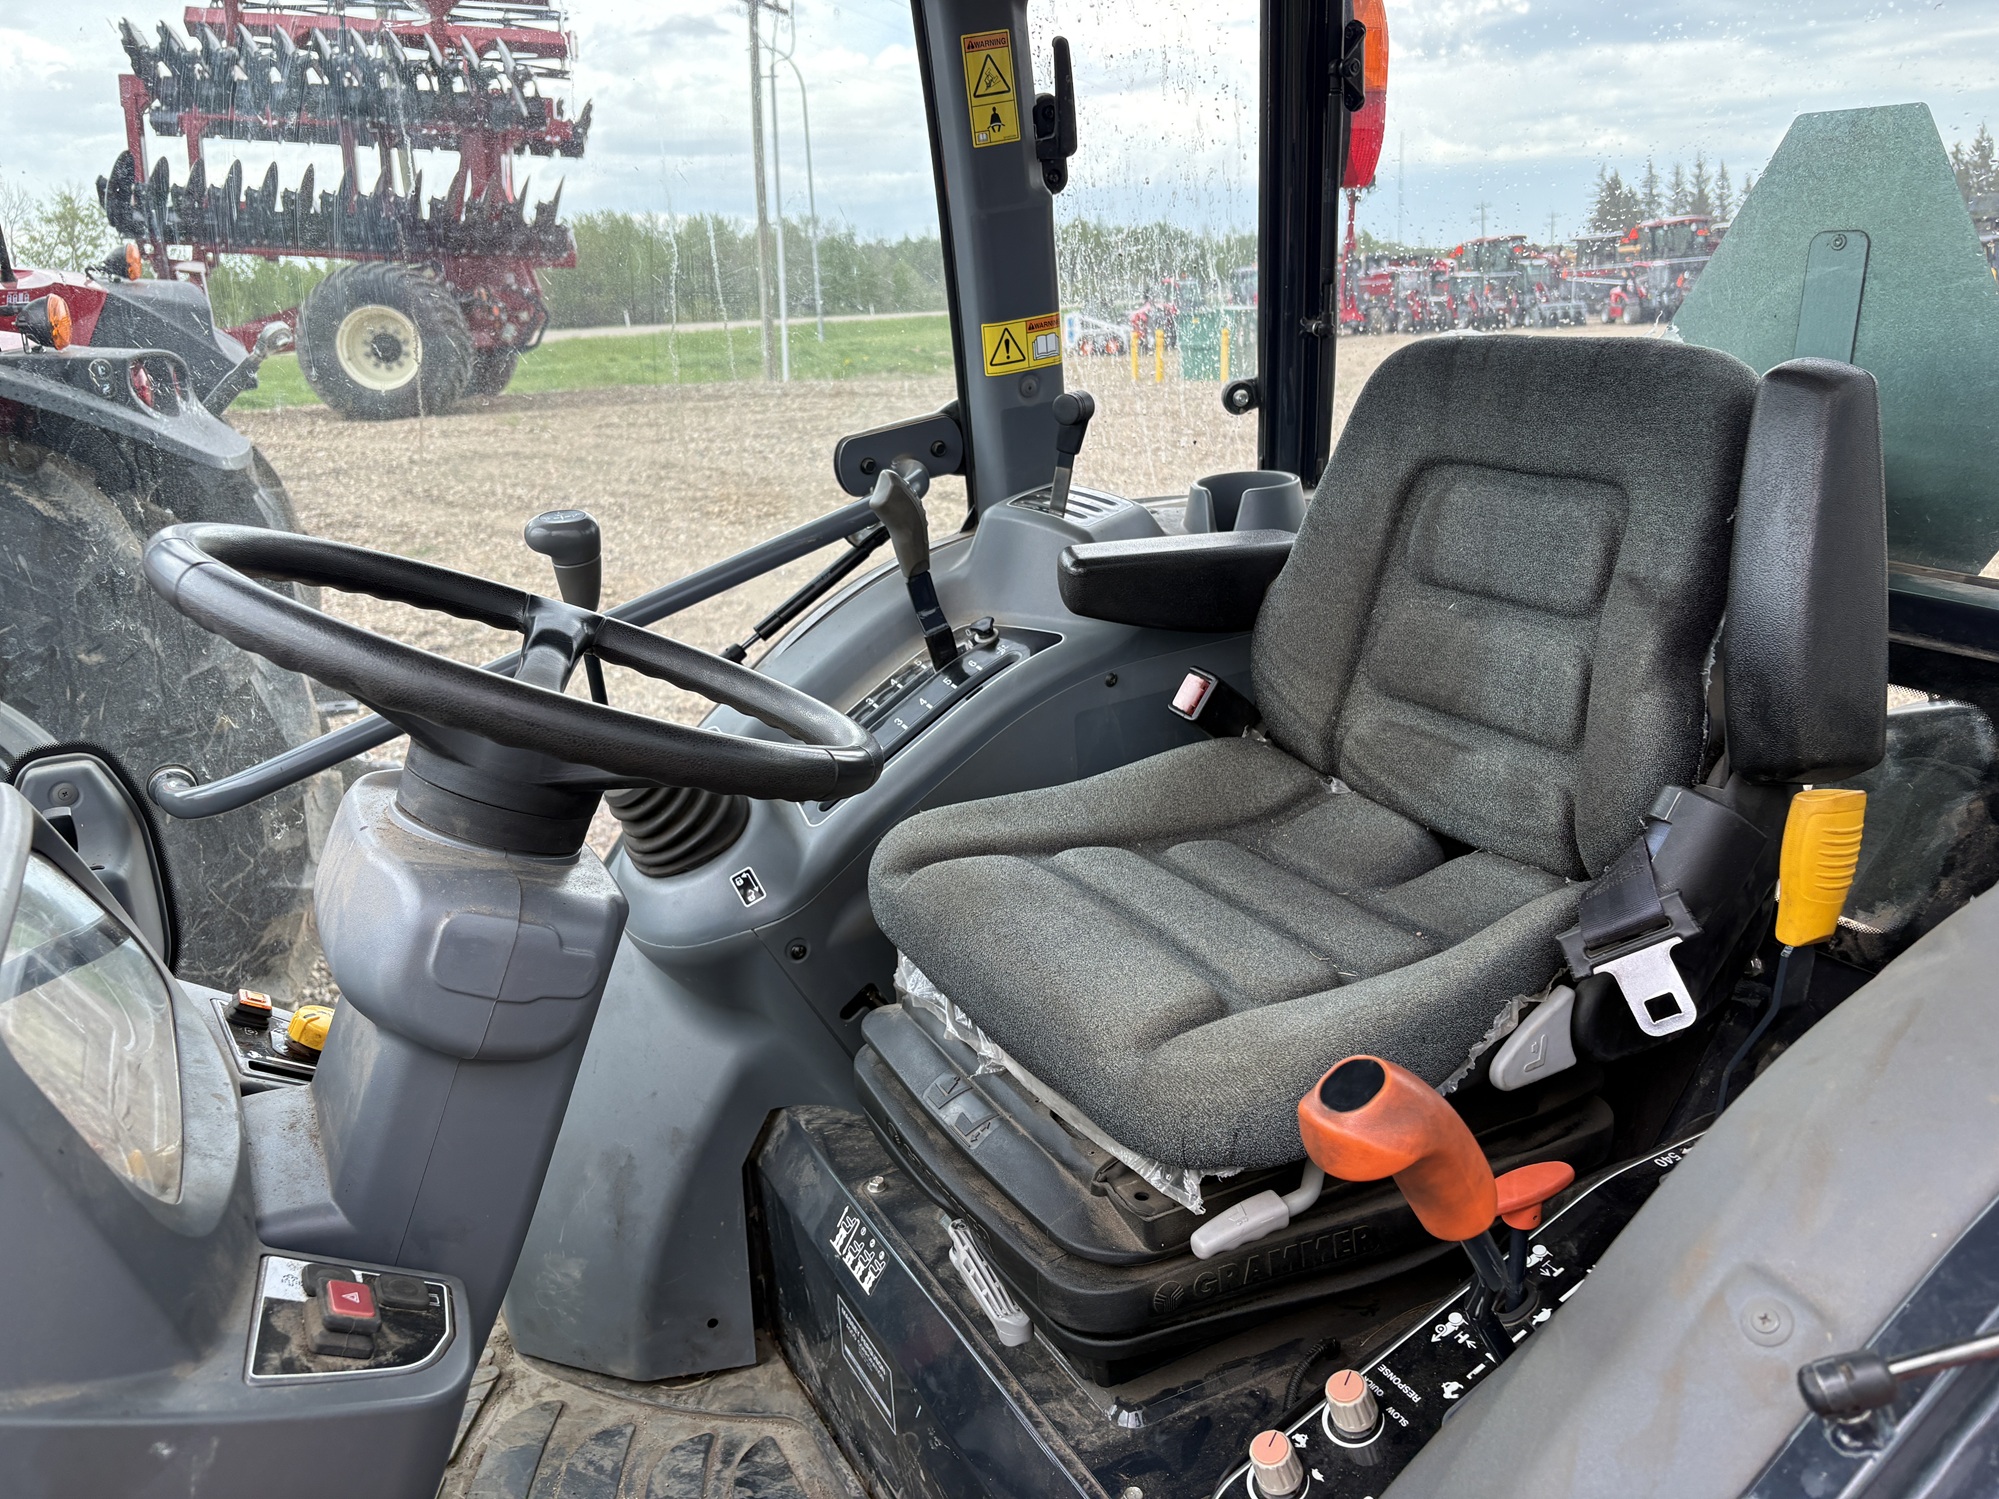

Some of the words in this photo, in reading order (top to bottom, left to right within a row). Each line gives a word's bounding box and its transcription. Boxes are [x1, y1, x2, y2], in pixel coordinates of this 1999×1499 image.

[973, 37, 1006, 48] WARNING
[890, 678, 898, 686] 4
[942, 678, 952, 686] 5
[865, 697, 874, 705] 3
[919, 697, 927, 706] 4
[893, 717, 903, 725] 3
[1654, 1152, 1682, 1167] 540
[1193, 1225, 1380, 1299] GRAMMER
[1377, 1363, 1422, 1403] RESPONSE
[1385, 1406, 1409, 1427] SLOW
